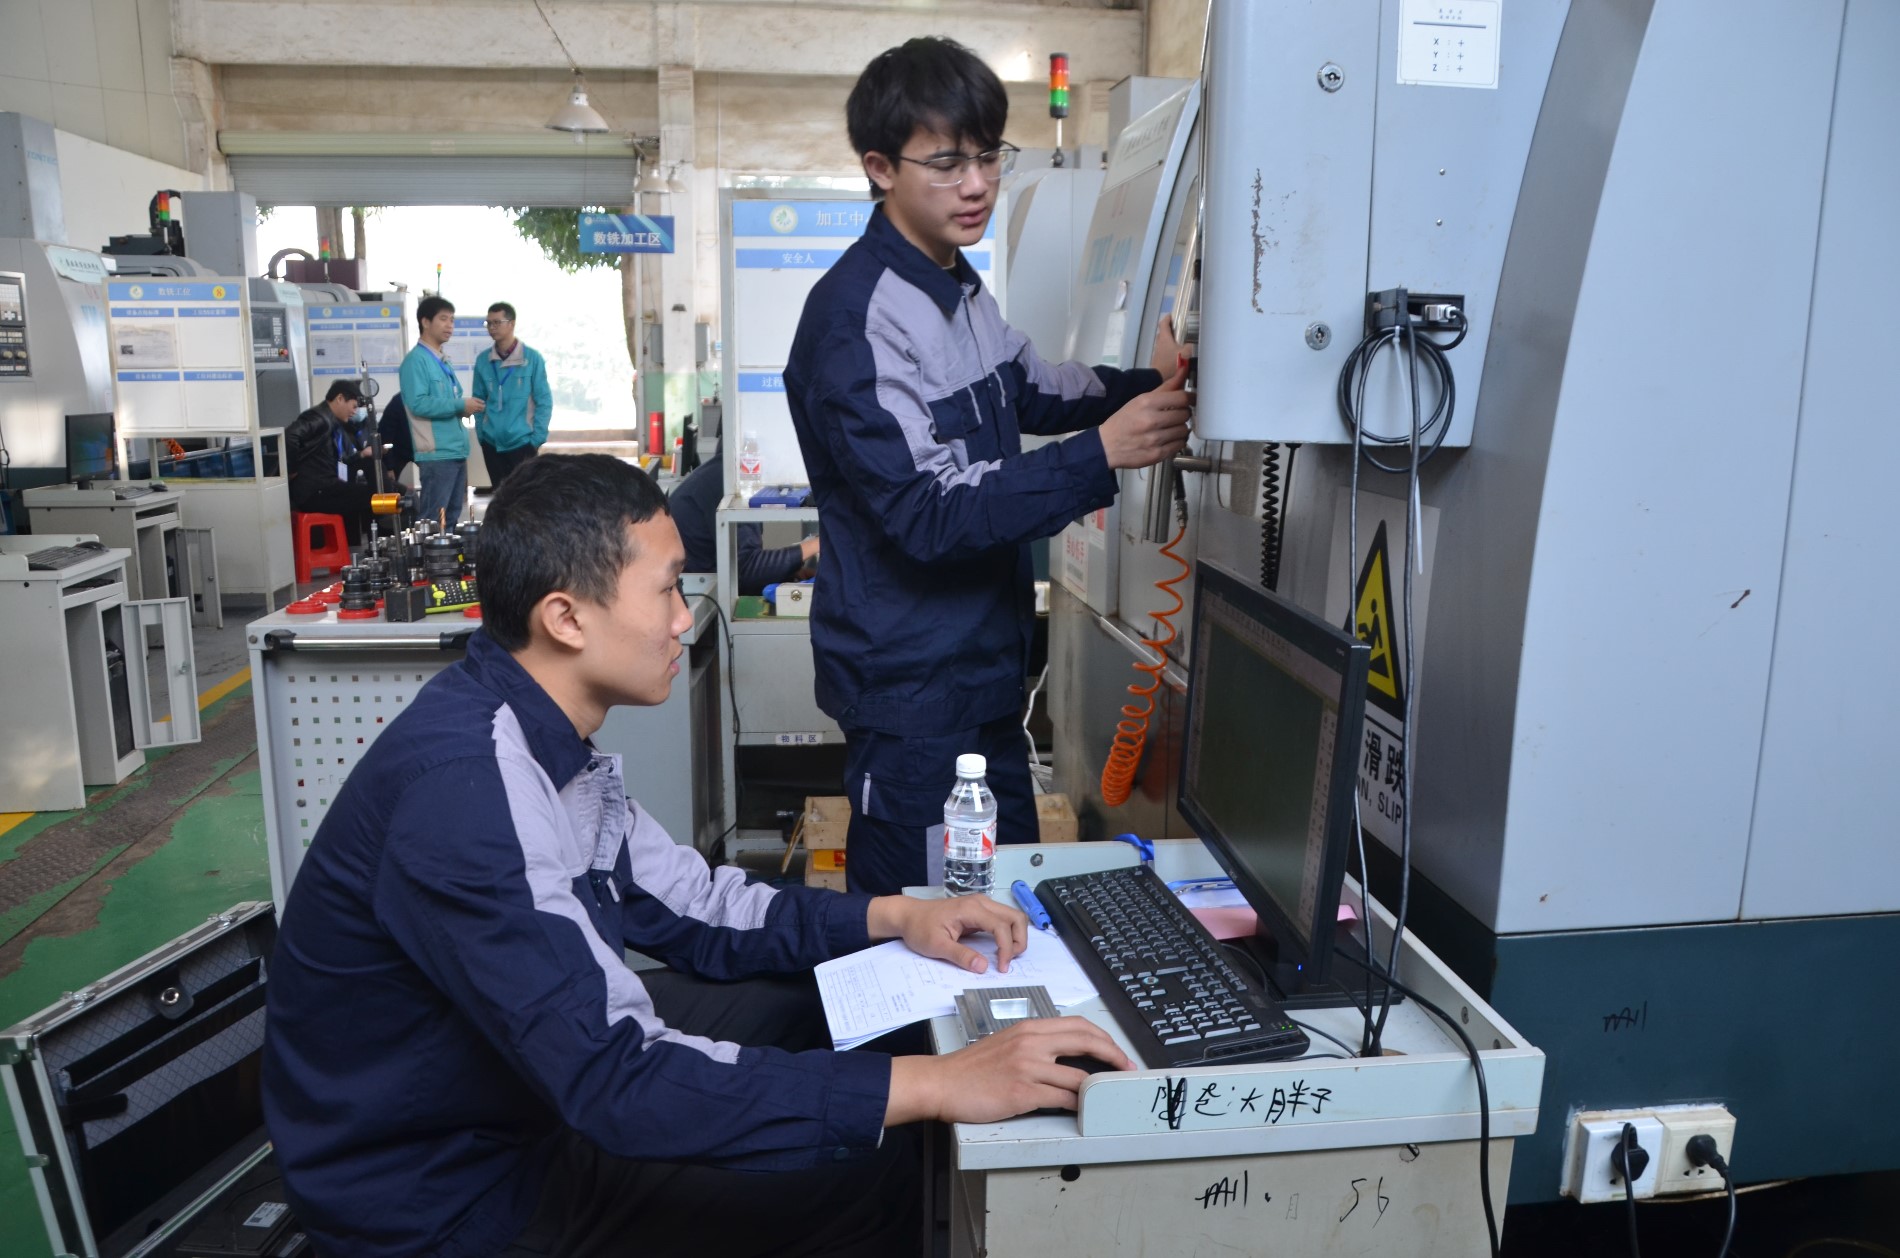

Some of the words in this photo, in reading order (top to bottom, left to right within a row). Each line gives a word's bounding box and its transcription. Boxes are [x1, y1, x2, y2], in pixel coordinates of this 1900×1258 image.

[815, 210, 869, 227] 加工中
[593, 231, 662, 246] 数铣加工区
[781, 734, 816, 743] 物料区
